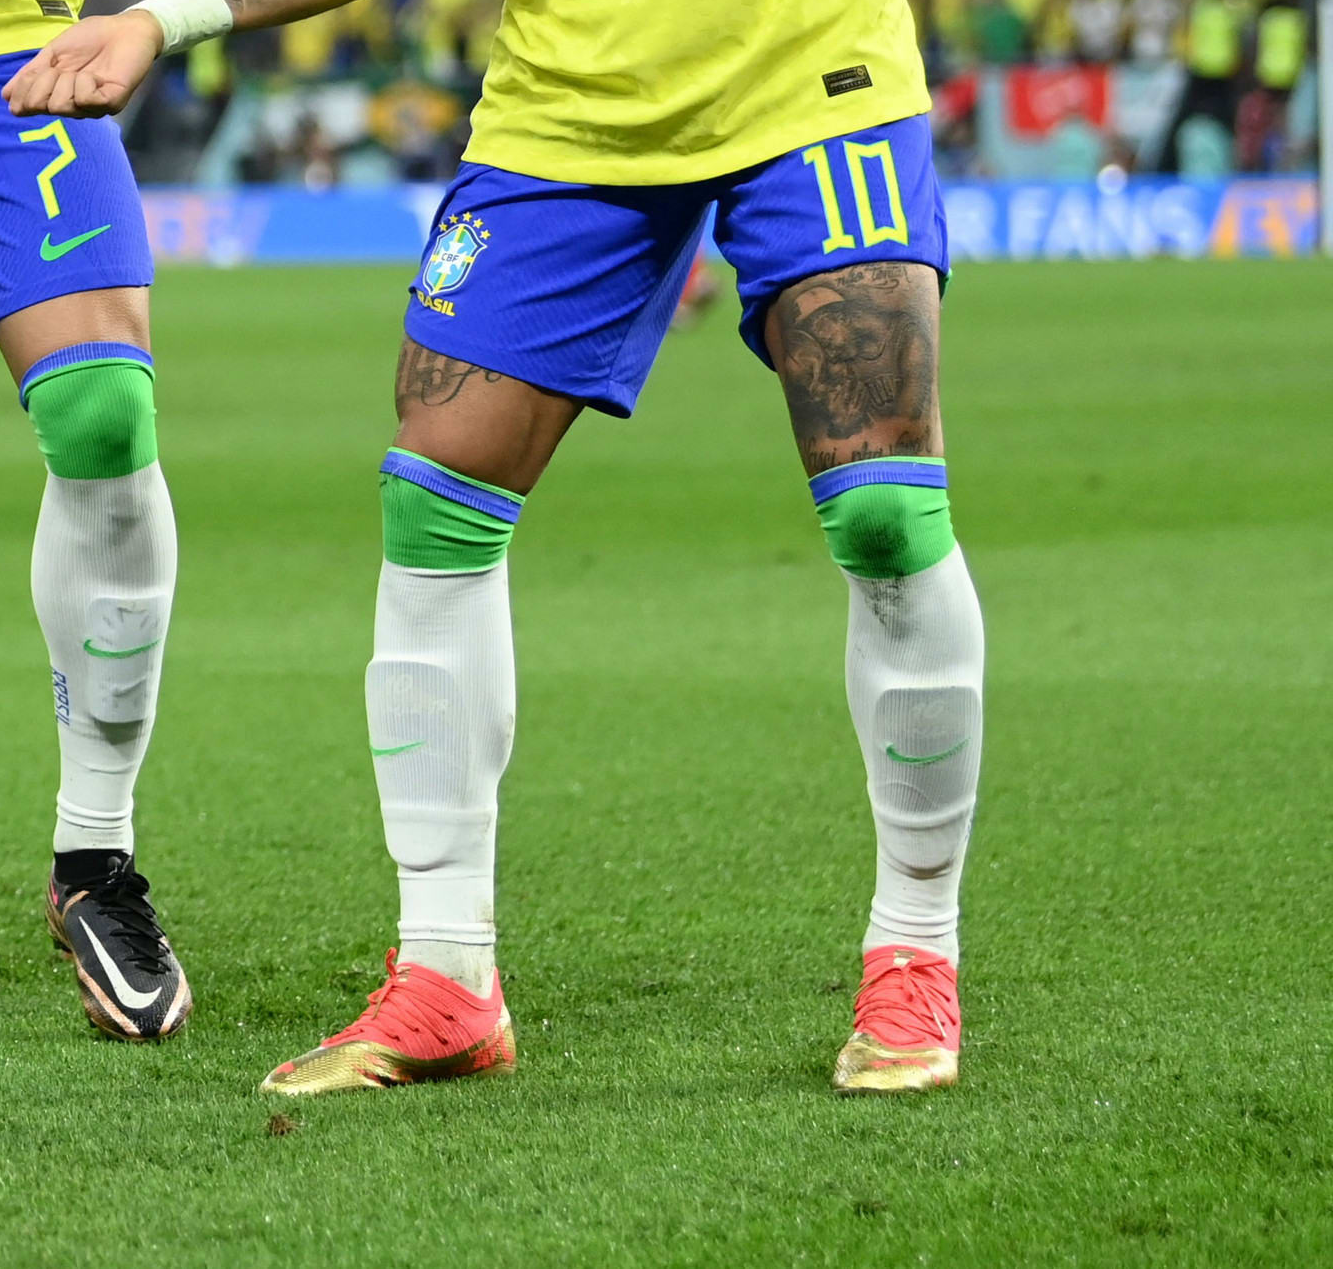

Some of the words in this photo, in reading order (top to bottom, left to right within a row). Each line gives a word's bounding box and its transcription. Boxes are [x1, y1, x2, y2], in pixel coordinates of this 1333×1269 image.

[18, 119, 78, 219] 7
[801, 139, 909, 255] 10
[441, 252, 460, 262] CBF
[1006, 184, 1207, 261] FANS
[417, 290, 455, 317] RASIL
